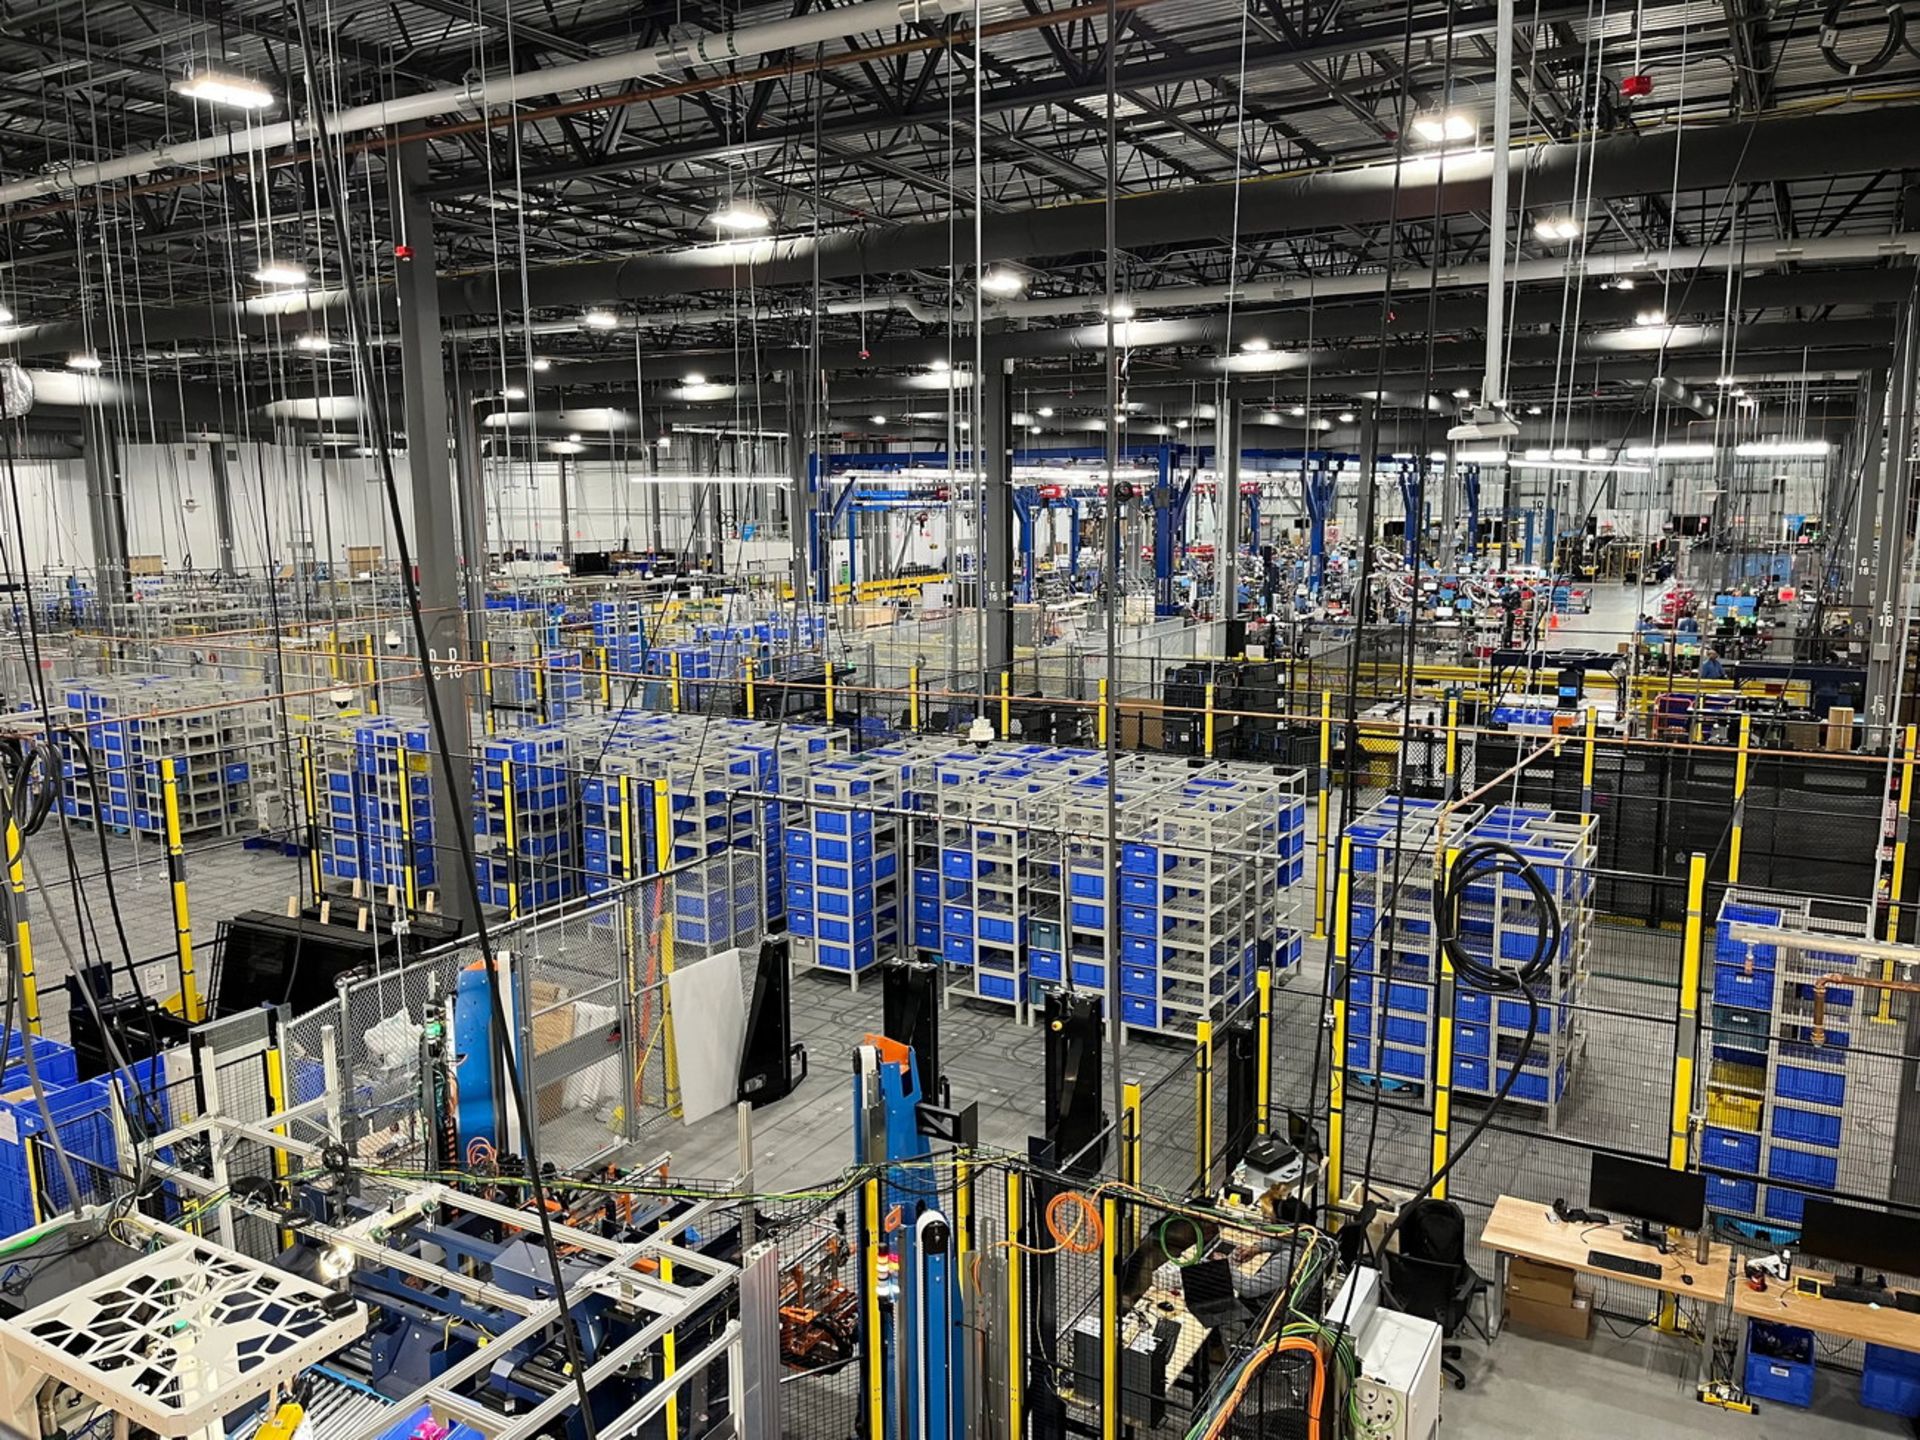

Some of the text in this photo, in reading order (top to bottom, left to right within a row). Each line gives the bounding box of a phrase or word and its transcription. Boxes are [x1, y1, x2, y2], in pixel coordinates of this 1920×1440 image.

[1860, 557, 1868, 567] G
[1858, 566, 1869, 575] 18
[990, 581, 996, 591] E
[1878, 614, 1893, 627] 18
[448, 647, 457, 662] D
